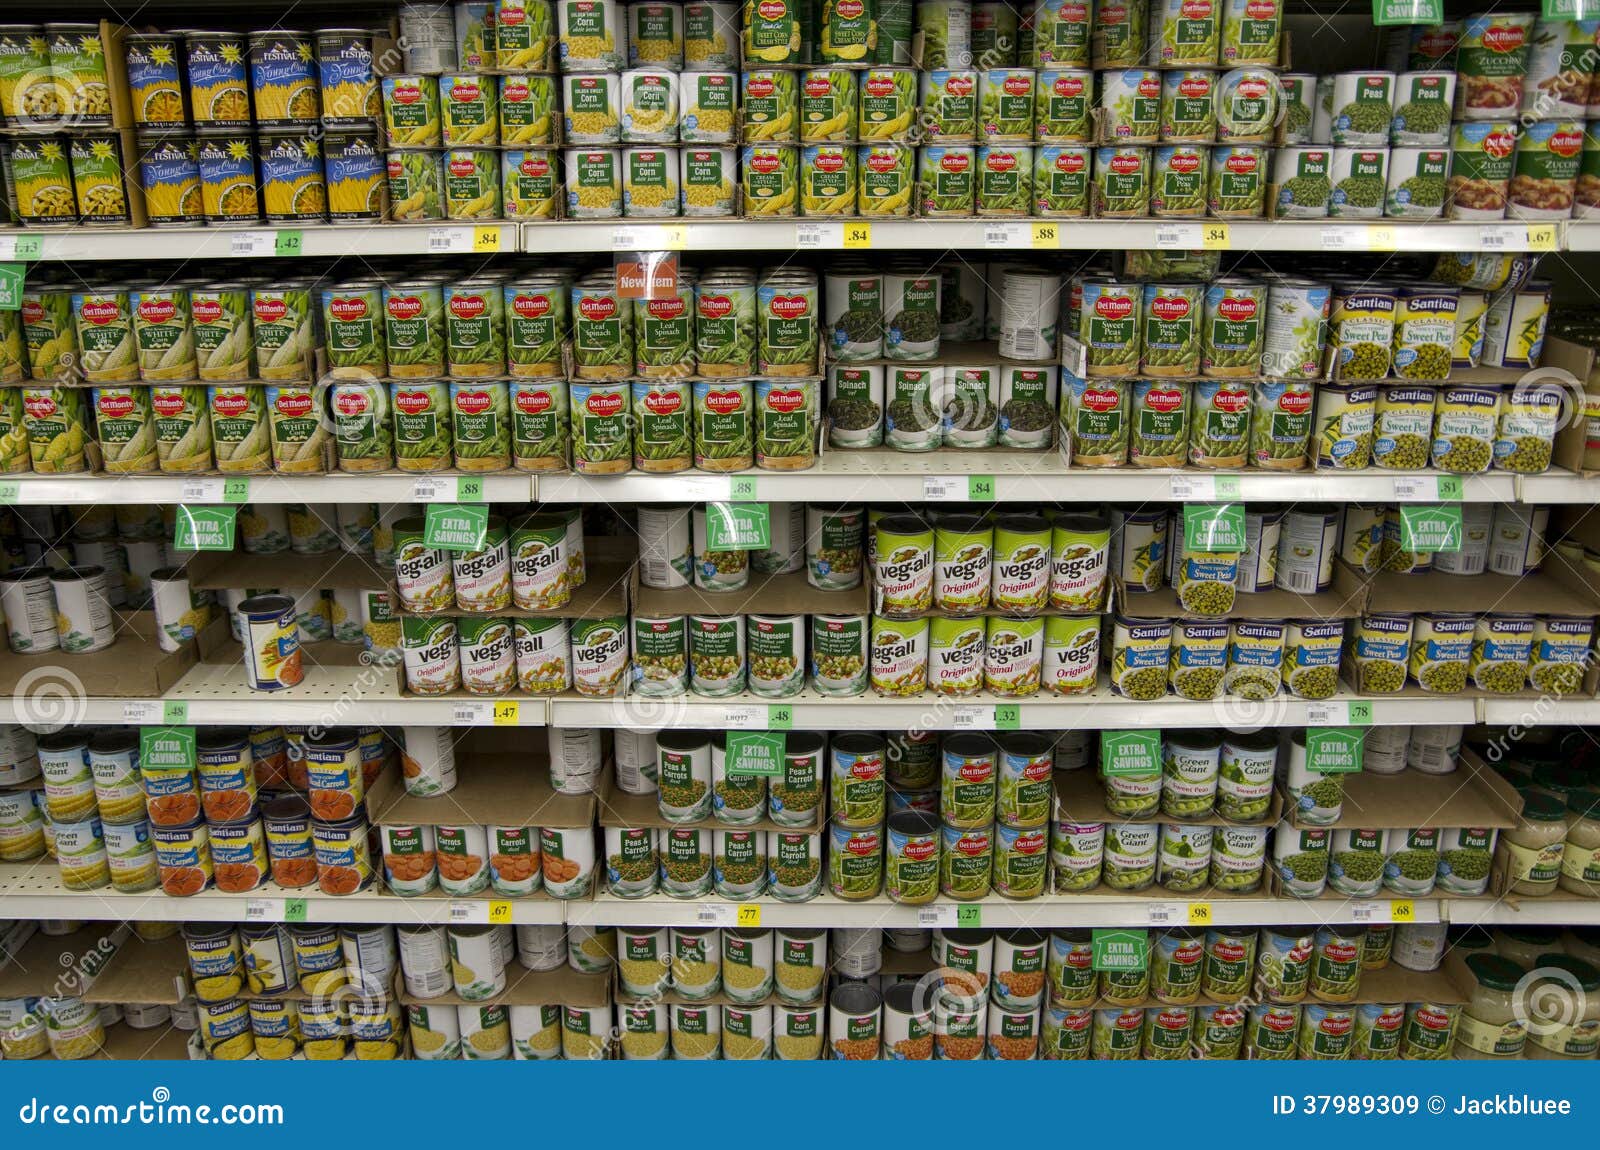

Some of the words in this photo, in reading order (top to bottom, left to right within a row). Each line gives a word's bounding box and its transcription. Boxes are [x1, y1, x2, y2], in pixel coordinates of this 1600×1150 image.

[577, 18, 594, 27] Corn
[264, 52, 297, 62] FESTIVAL
[581, 94, 598, 103] Corn
[709, 92, 725, 101] Corn
[1364, 89, 1383, 98] Peas
[1418, 89, 1439, 98] Peas
[155, 151, 188, 161] FESTIVAL
[344, 147, 376, 157] FESTIVAL
[639, 168, 656, 176] Corn
[1305, 163, 1323, 173] Peas
[1424, 163, 1442, 173] Peas
[588, 169, 605, 178] Corn
[478, 234, 497, 245] .84
[849, 230, 867, 241] .84
[1036, 229, 1055, 240] .88
[1207, 230, 1225, 241] .84
[1525, 231, 1551, 243] 1.67
[274, 238, 299, 249] 1.42
[621, 277, 645, 288] New
[852, 291, 879, 302] Spinach
[907, 290, 935, 302] Spinach
[452, 301, 462, 310] Del
[462, 301, 484, 310] Monte
[581, 302, 591, 312] Del
[592, 302, 614, 312] Monte
[650, 302, 661, 311] Del
[662, 301, 684, 310] Monte
[1097, 302, 1110, 311] Del
[1110, 301, 1132, 311] Monte
[1154, 302, 1165, 312] Del
[1166, 302, 1188, 311] Monte
[1221, 303, 1232, 312] Del
[1233, 303, 1255, 312] Monte
[1346, 298, 1392, 310] Santiam
[1410, 297, 1457, 310] Santiam
[455, 320, 482, 330] Chopped
[518, 320, 546, 330] Chopped
[590, 322, 605, 331] Leaf
[660, 320, 675, 329] Leaf
[1102, 321, 1124, 330] Sweet
[1157, 322, 1180, 331] Sweet
[456, 328, 481, 338] Spinach
[519, 328, 545, 338] Spinach
[585, 328, 611, 339] Spinach
[655, 327, 680, 337] Spinach
[1104, 328, 1121, 337] Peas
[1160, 328, 1177, 338] Peas
[1343, 328, 1369, 341] Sweet
[838, 380, 866, 391] Spinach
[898, 380, 926, 392] Spinach
[1015, 380, 1043, 392] Spinach
[1390, 390, 1432, 402] Santiam
[1446, 390, 1493, 406] Santiam
[589, 400, 599, 409] Del
[600, 399, 622, 409] Monte
[717, 416, 732, 425] Leaf
[1088, 413, 1110, 422] Sweet
[461, 422, 487, 432] Spinach
[711, 422, 737, 432] Spinach
[1090, 419, 1108, 428] Peas
[1443, 422, 1468, 436] Sweet
[224, 484, 246, 495] 1.22
[461, 483, 480, 495] .88
[972, 483, 991, 494] .84
[1440, 481, 1457, 493] .81
[442, 518, 470, 531] EXTRA
[1418, 520, 1447, 532] EXTRA
[434, 530, 475, 544] SAVINGS
[1413, 533, 1454, 546] SAVINGS
[943, 578, 981, 595] Original
[999, 579, 1037, 594] Original
[1363, 617, 1407, 631] Santiam
[829, 630, 859, 640] Vegetables
[1187, 626, 1226, 639] Santiam
[1237, 625, 1280, 638] Santiam
[417, 662, 446, 677] Original
[468, 661, 496, 677] Original
[1056, 664, 1093, 678] Original
[168, 706, 184, 718] .48
[493, 708, 516, 718] 1.47
[771, 710, 789, 722] .48
[993, 711, 1016, 721] 1.32
[1352, 706, 1369, 718] .78
[154, 740, 181, 752] EXTRA
[742, 745, 770, 757] EXTRA
[1119, 744, 1146, 756] EXTRA
[1321, 741, 1348, 753] EXTRA
[149, 752, 186, 764] SAVINGS
[1113, 756, 1152, 769] SAVINGS
[1314, 753, 1353, 766] SAVINGS
[664, 761, 679, 771] Peas
[736, 757, 776, 770] SAVINGS
[664, 770, 688, 779] Carrots
[1120, 831, 1150, 841] Green
[1227, 831, 1256, 841] Green
[1466, 836, 1486, 846] Peas
[393, 838, 418, 847] Carrots
[501, 838, 526, 847] Carrots
[671, 838, 688, 847] Peas
[728, 841, 745, 850] Peas
[1120, 838, 1148, 847] Giant
[1227, 839, 1254, 849] Giant
[1306, 839, 1325, 849] Peas
[1356, 839, 1376, 849] Peas
[1414, 837, 1433, 847] Peas
[671, 845, 696, 855] Carrots
[728, 848, 753, 858] Carrots
[288, 904, 303, 915] .87
[492, 905, 508, 917] .67
[740, 908, 757, 920] .77
[957, 909, 979, 920] 1.27
[1191, 907, 1208, 918] .98
[1393, 905, 1410, 916] .68
[190, 940, 227, 951] Santiam
[633, 946, 649, 955] Corn
[1108, 942, 1134, 954] EXTRA
[790, 950, 806, 960] Corn
[1017, 957, 1040, 967] Carrots
[1102, 954, 1139, 967] SAVINGS
[684, 1018, 699, 1027] Corn
[795, 1021, 810, 1031] Corn
[852, 1023, 874, 1033] Carrots
